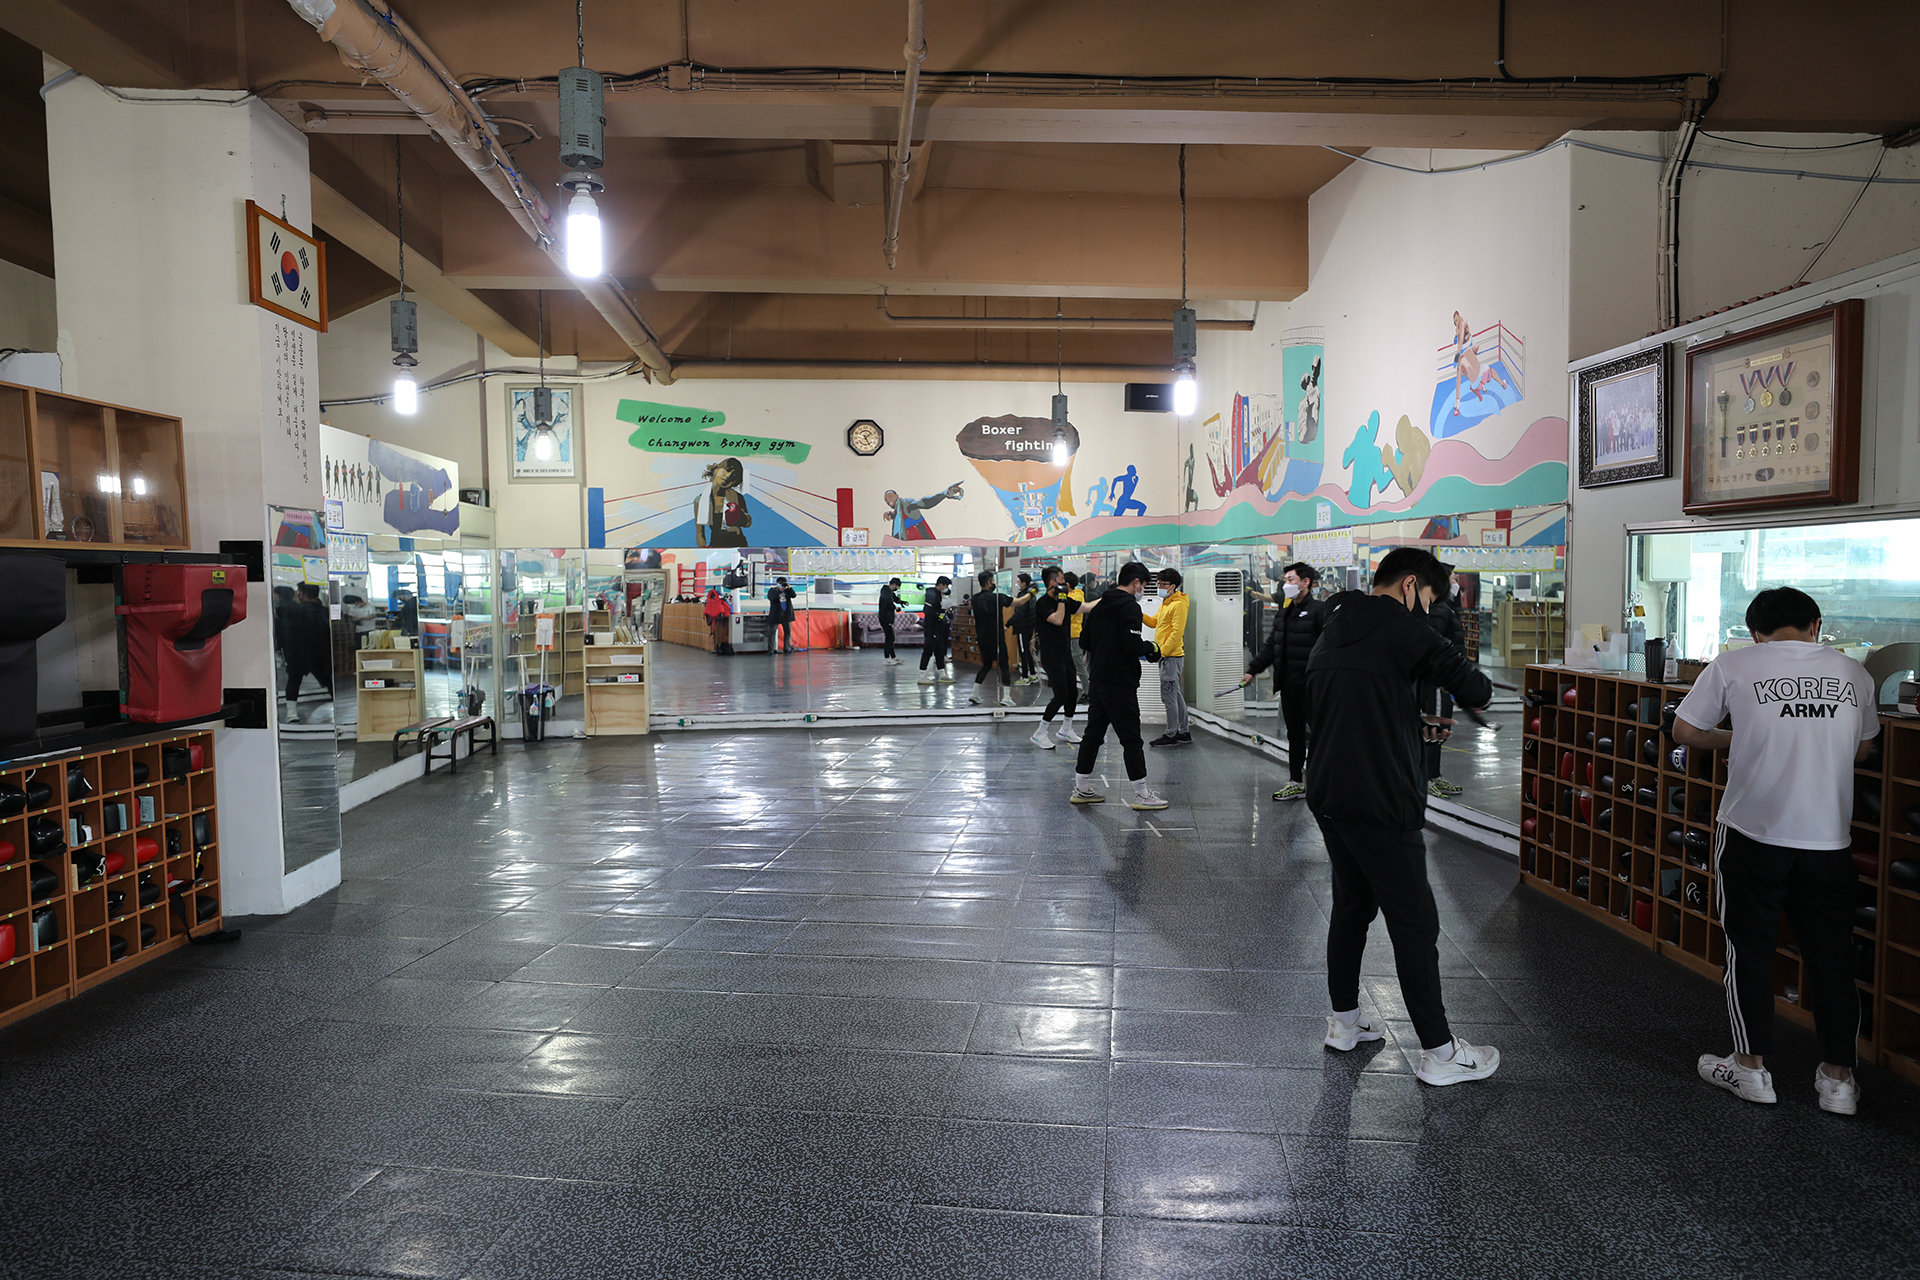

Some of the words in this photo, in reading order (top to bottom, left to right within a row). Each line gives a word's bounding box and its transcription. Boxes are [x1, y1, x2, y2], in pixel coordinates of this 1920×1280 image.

[638, 414, 692, 424] Welcome
[701, 415, 715, 424] to
[981, 424, 1023, 435] Boxer
[648, 438, 711, 451] Changwon
[720, 438, 761, 451] Boxing
[768, 440, 796, 451] gym
[1004, 440, 1063, 452] fightin
[1753, 676, 1859, 708] KOREA
[1780, 703, 1839, 718] ARMY
